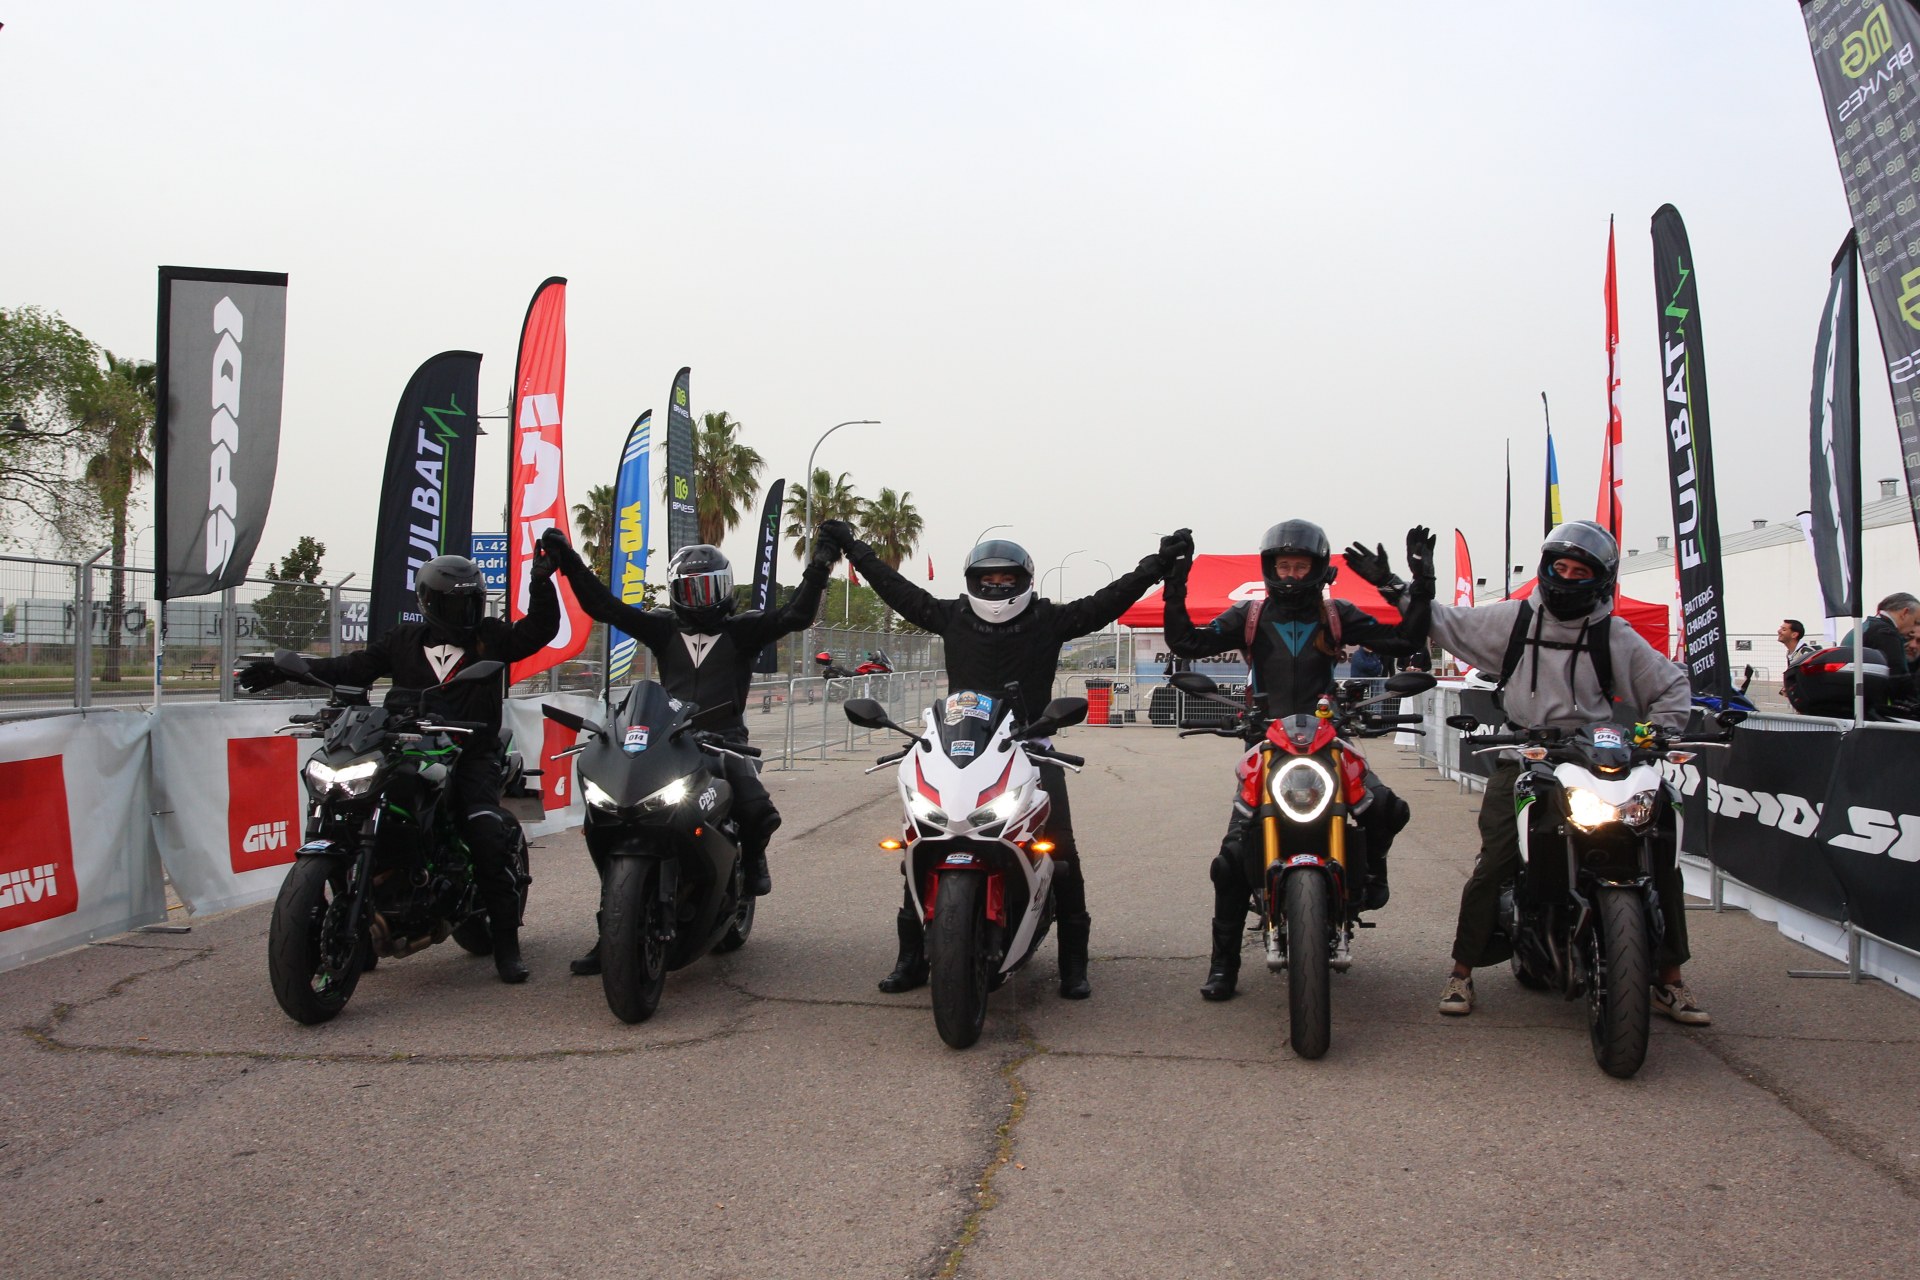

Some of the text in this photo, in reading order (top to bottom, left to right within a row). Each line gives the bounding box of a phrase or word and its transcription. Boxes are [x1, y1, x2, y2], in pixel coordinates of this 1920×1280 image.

[206, 296, 243, 580] SPIDI
[1665, 340, 1701, 570] FULBAT
[476, 542, 507, 551] A-42
[620, 501, 644, 604] WD-40
[759, 528, 774, 610] ULBAT
[243, 821, 287, 853] GIVI
